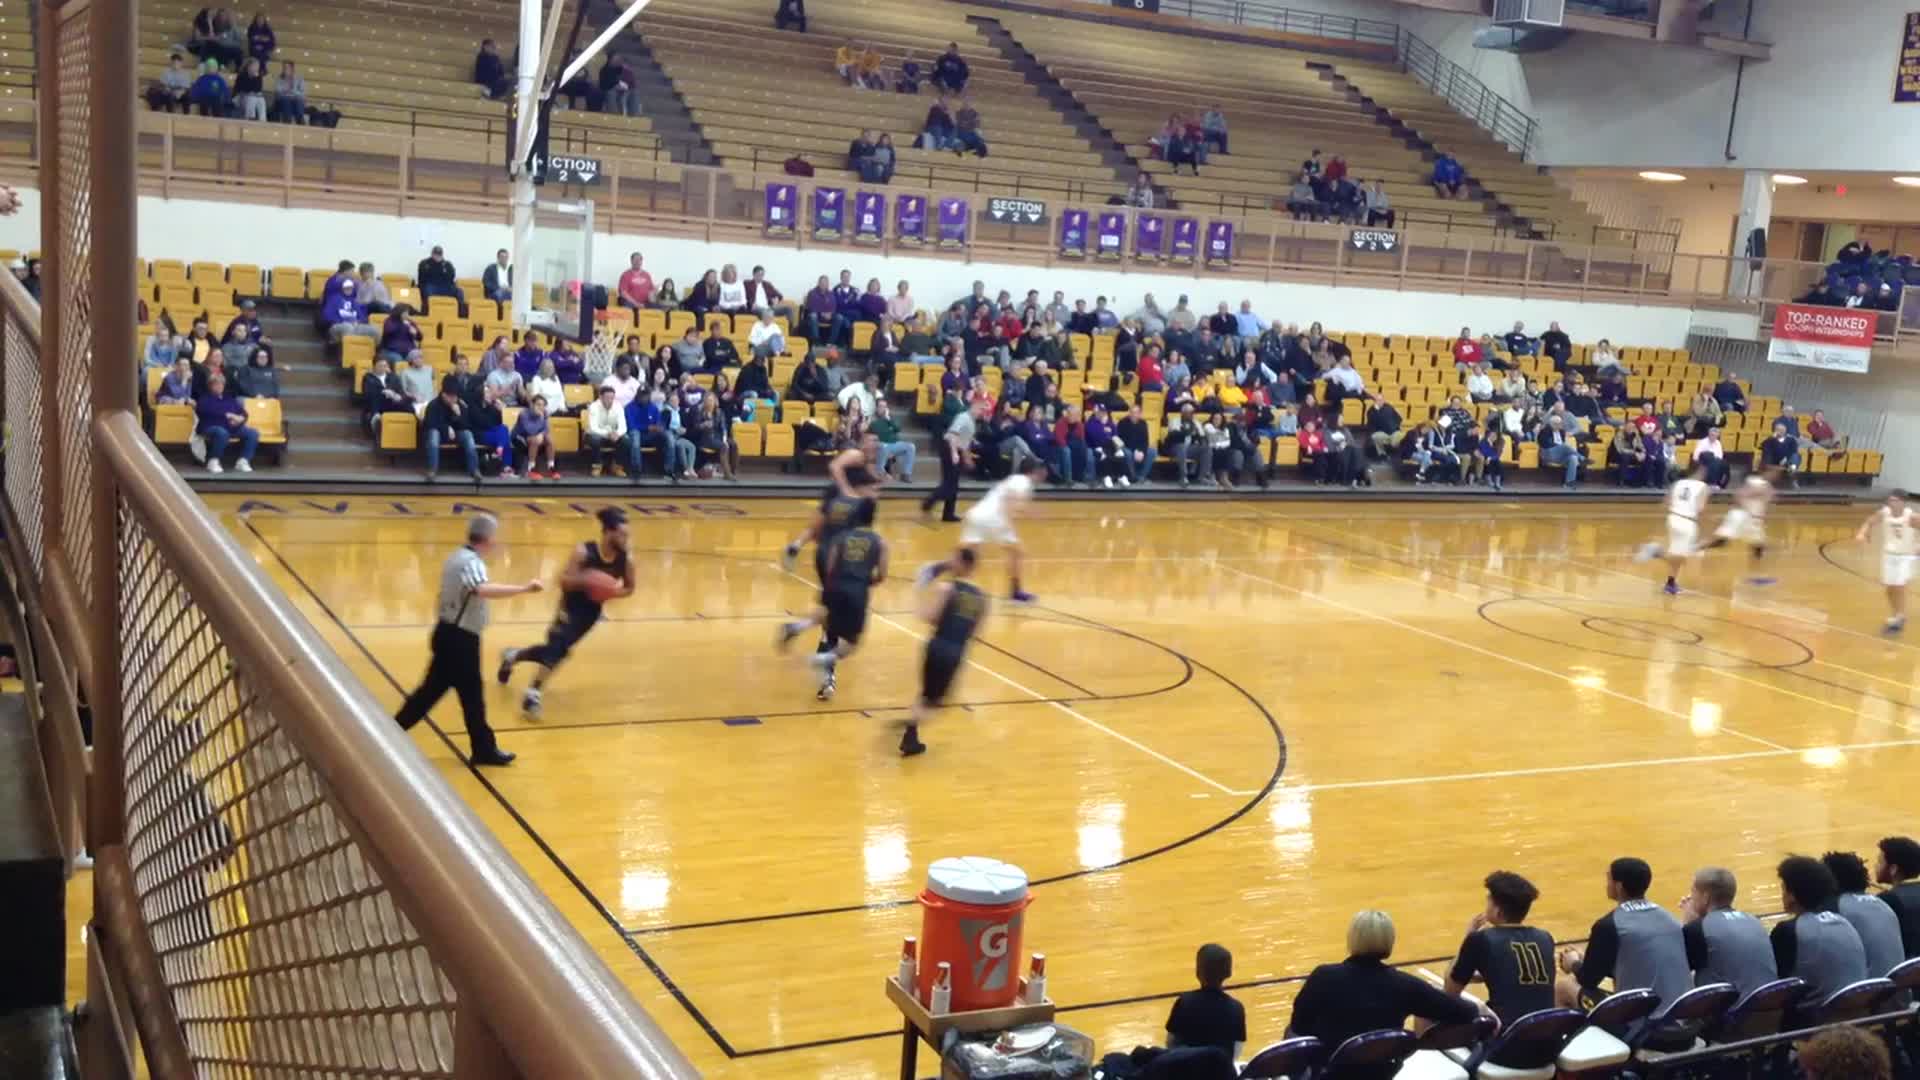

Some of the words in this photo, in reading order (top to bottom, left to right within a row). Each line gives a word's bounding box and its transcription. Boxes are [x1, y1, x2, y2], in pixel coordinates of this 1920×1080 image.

[549, 156, 597, 172] CTION
[559, 169, 569, 182] 2
[991, 198, 1043, 214] SECTION
[1011, 211, 1021, 223] 2
[1353, 231, 1396, 243] SECTION
[1370, 240, 1377, 250] 2
[1787, 311, 1868, 330] TOP-RANKED
[980, 923, 1009, 957] G
[1510, 941, 1549, 985] 11
